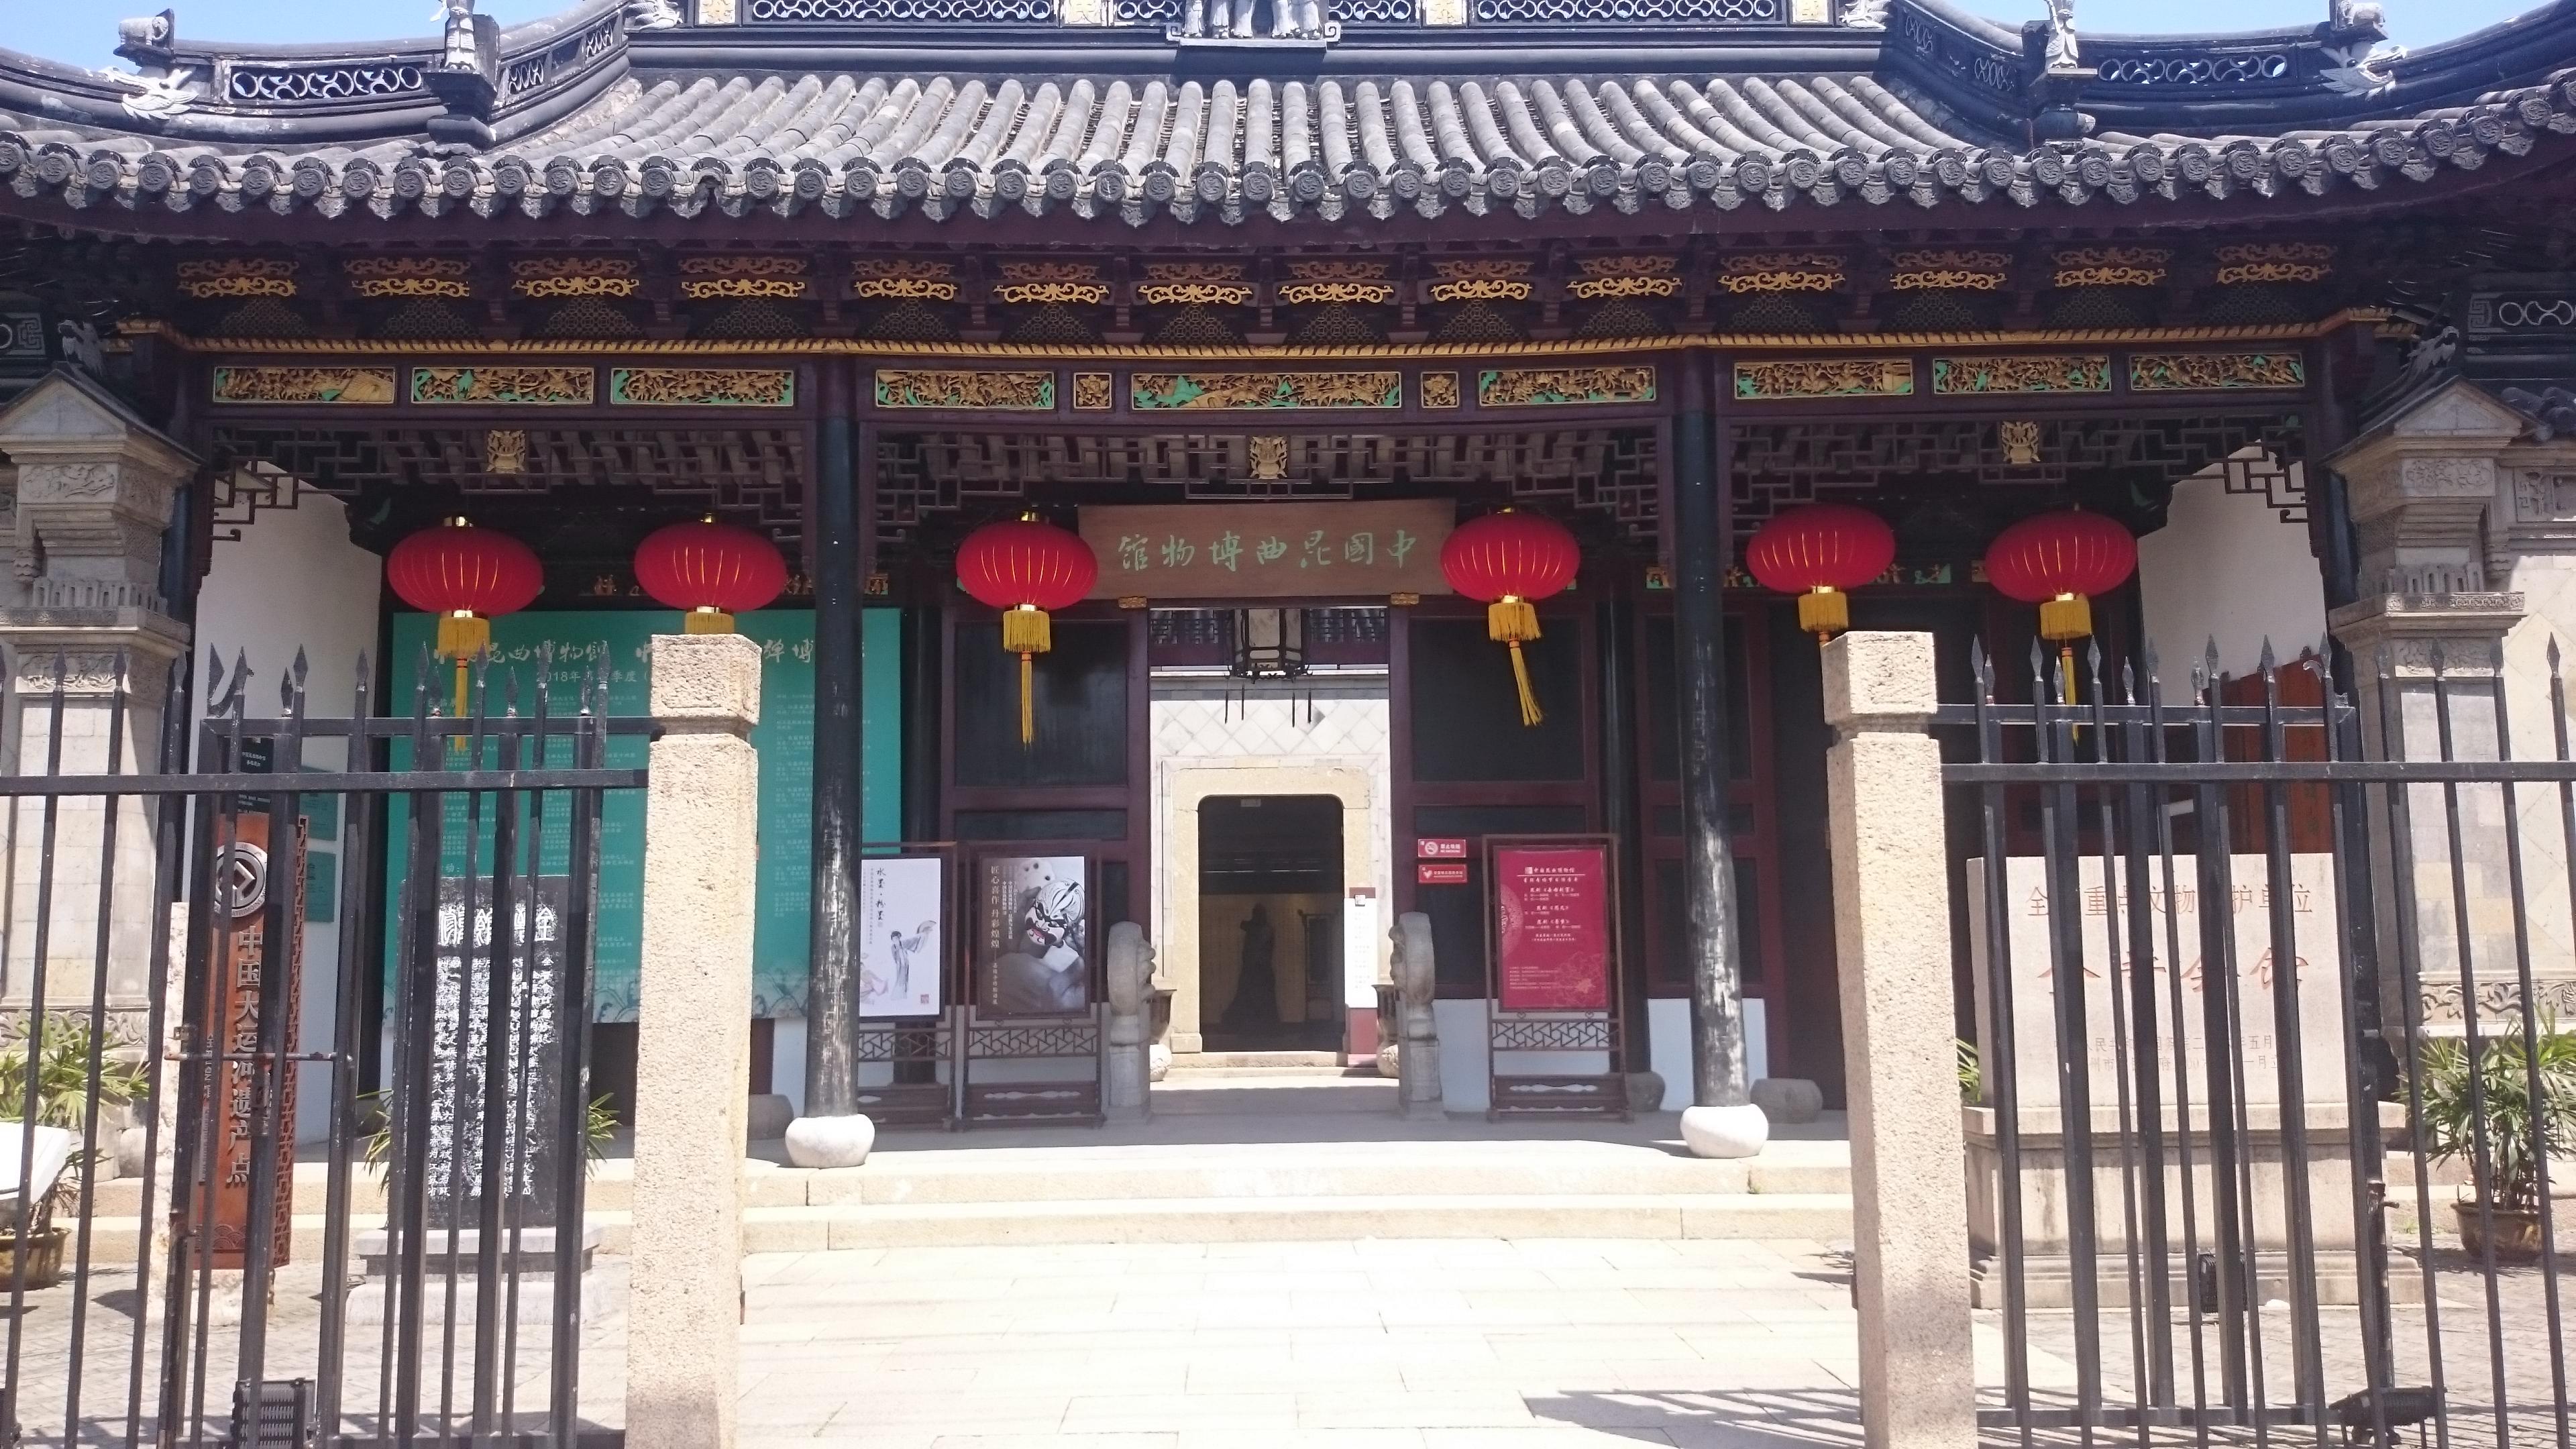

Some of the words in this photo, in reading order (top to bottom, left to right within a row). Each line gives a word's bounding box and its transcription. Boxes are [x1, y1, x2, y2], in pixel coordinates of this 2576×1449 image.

[2026, 885, 2313, 917] 全重文物护位
